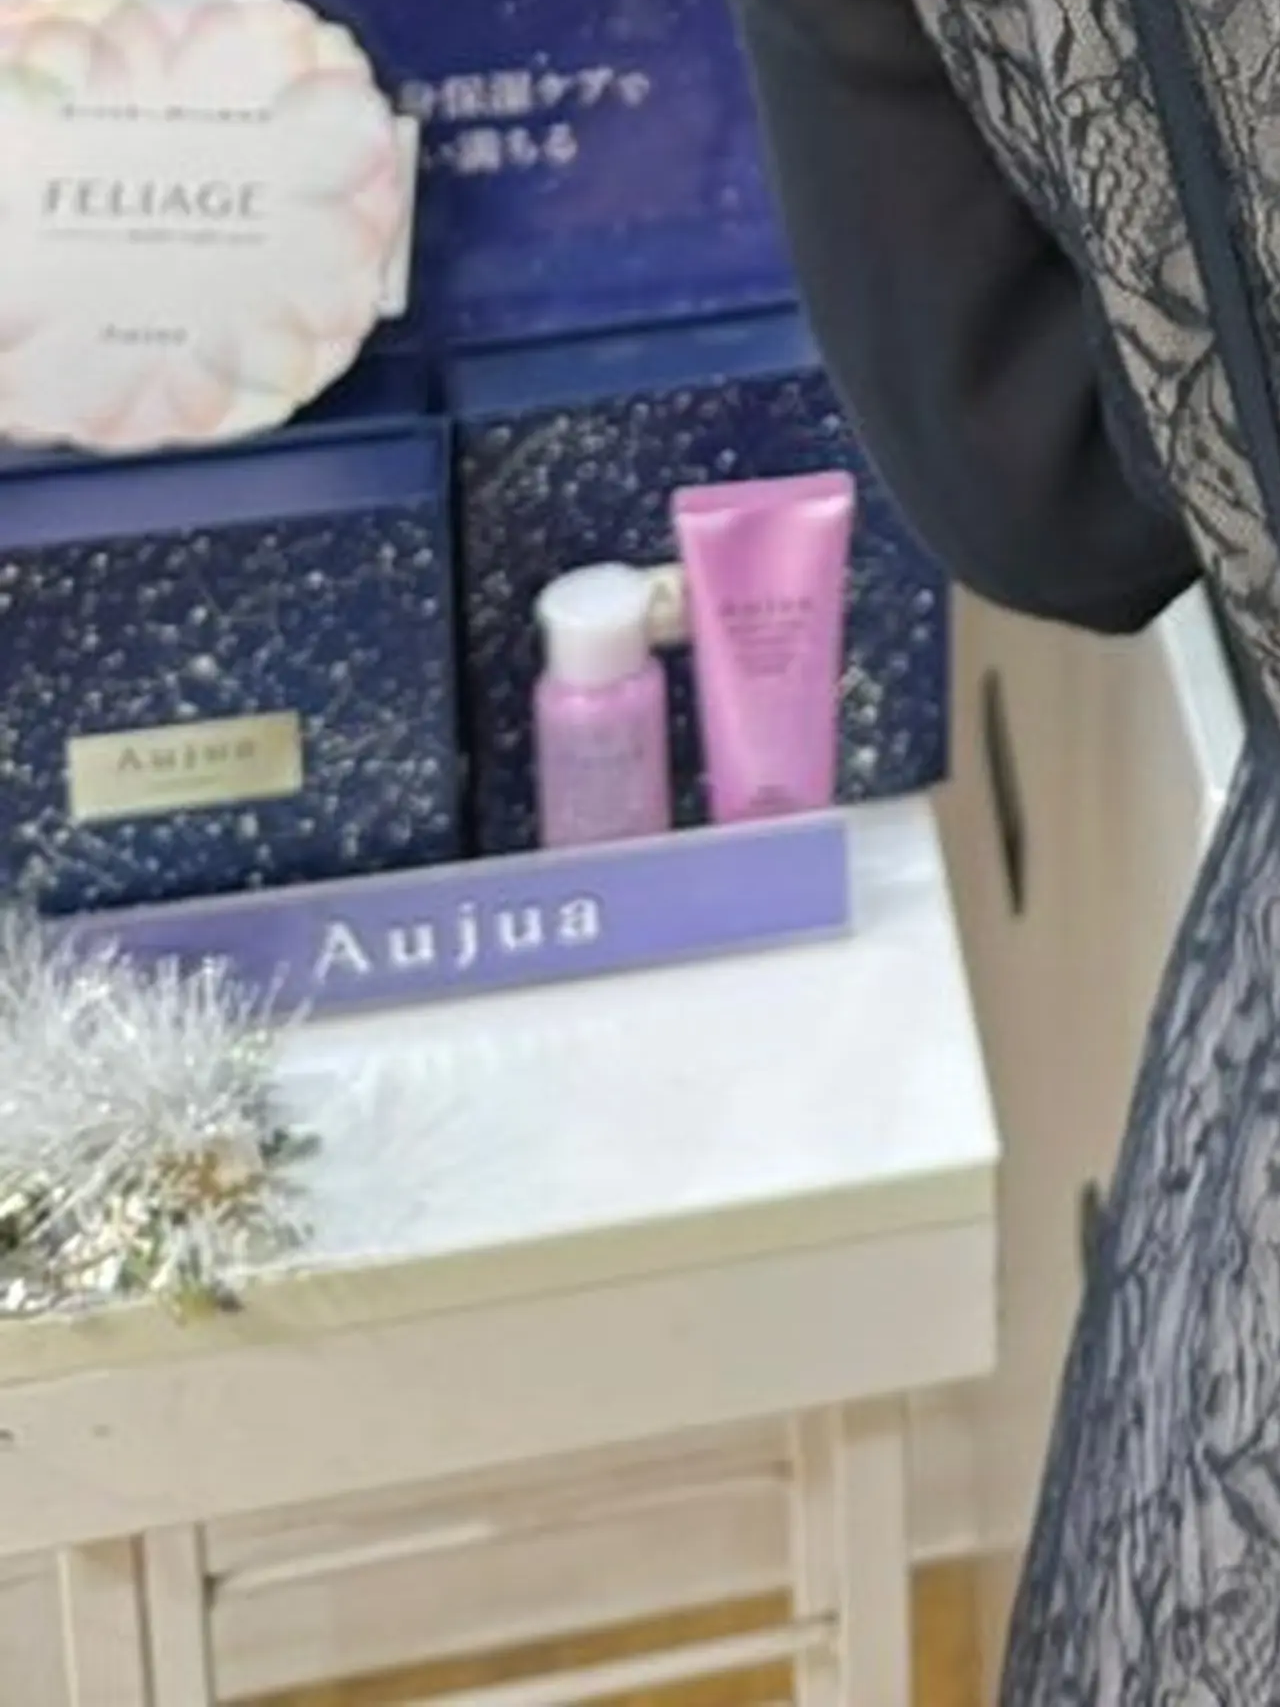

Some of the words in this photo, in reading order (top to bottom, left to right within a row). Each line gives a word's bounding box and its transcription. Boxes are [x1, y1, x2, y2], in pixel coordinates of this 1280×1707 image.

[42, 176, 272, 221] FELIAGE
[116, 739, 257, 773] Aujua
[312, 891, 603, 979] Aujua
